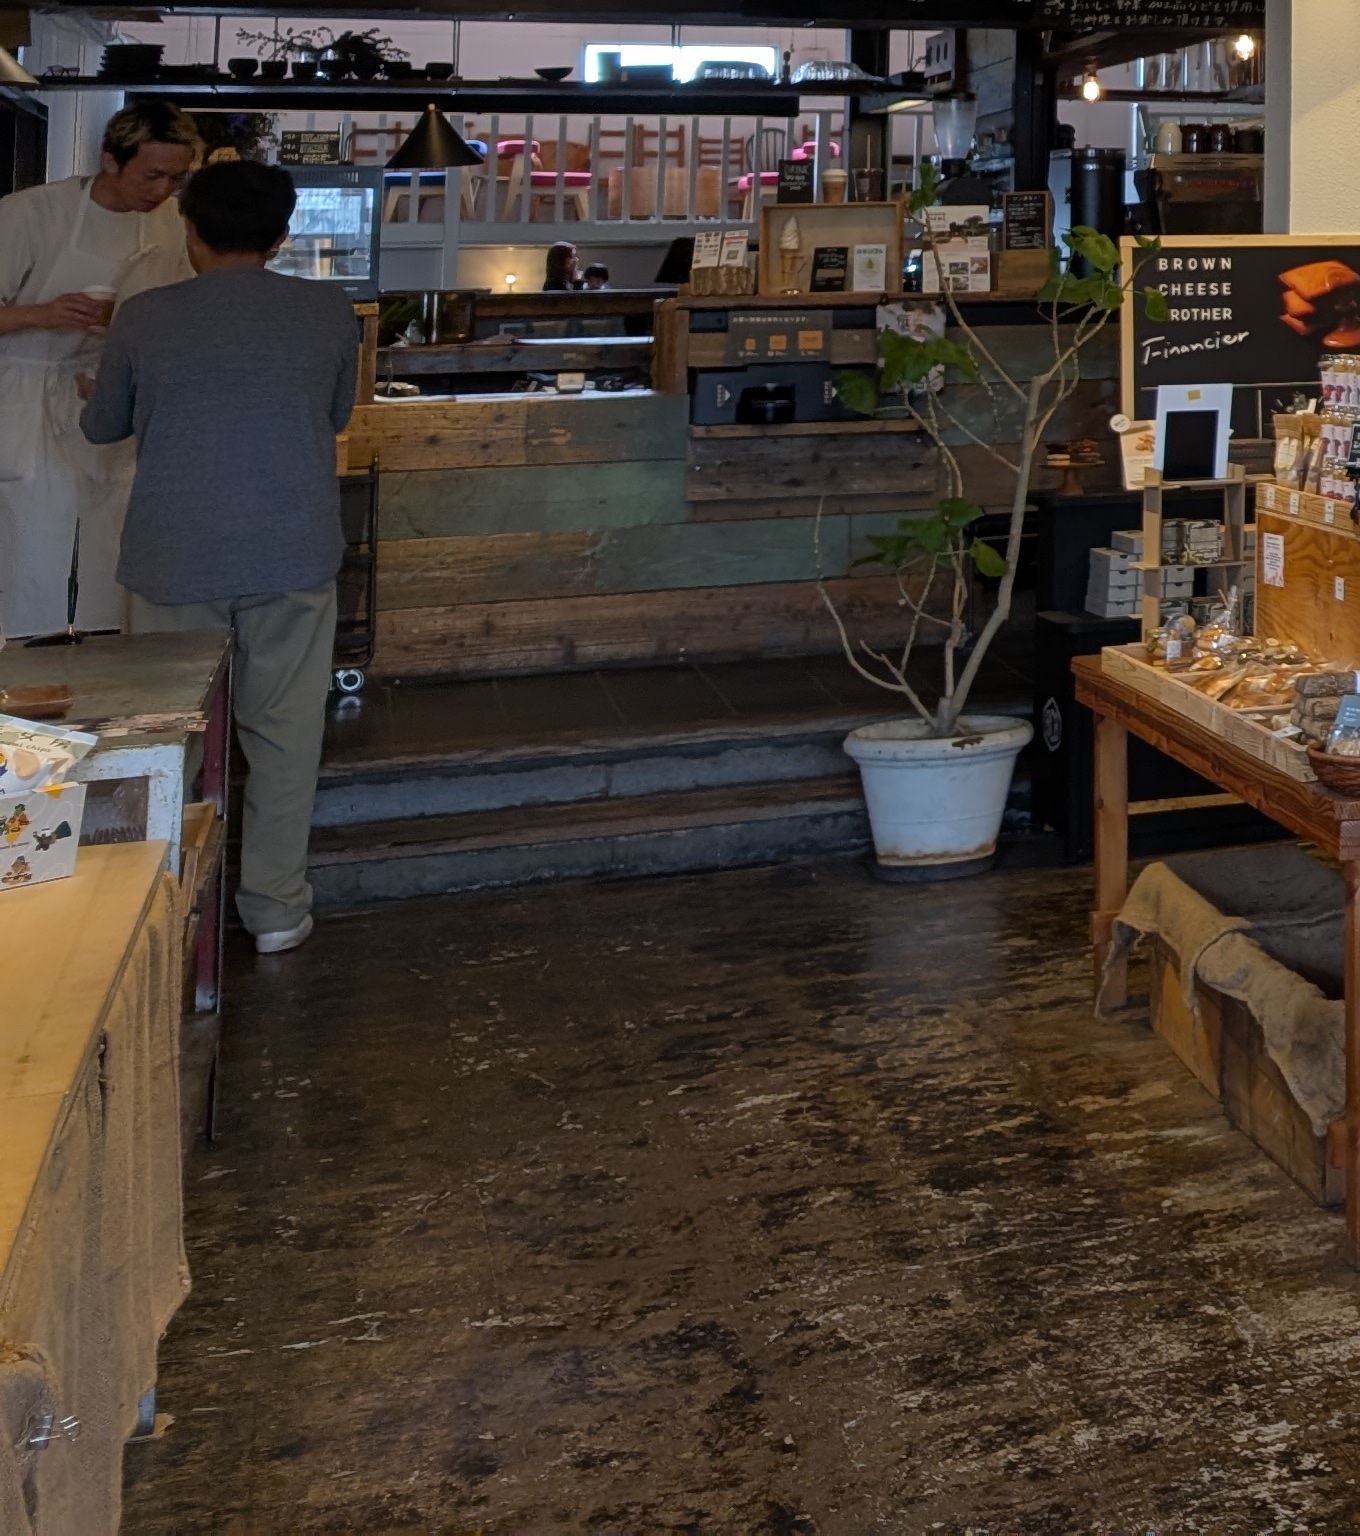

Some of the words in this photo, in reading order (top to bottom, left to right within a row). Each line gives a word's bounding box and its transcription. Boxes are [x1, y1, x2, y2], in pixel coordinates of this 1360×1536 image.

[1157, 256, 1233, 272] BROWN
[1158, 281, 1233, 297] CHEESE
[1167, 306, 1233, 322] ROTHER
[1141, 328, 1250, 365] Financier
